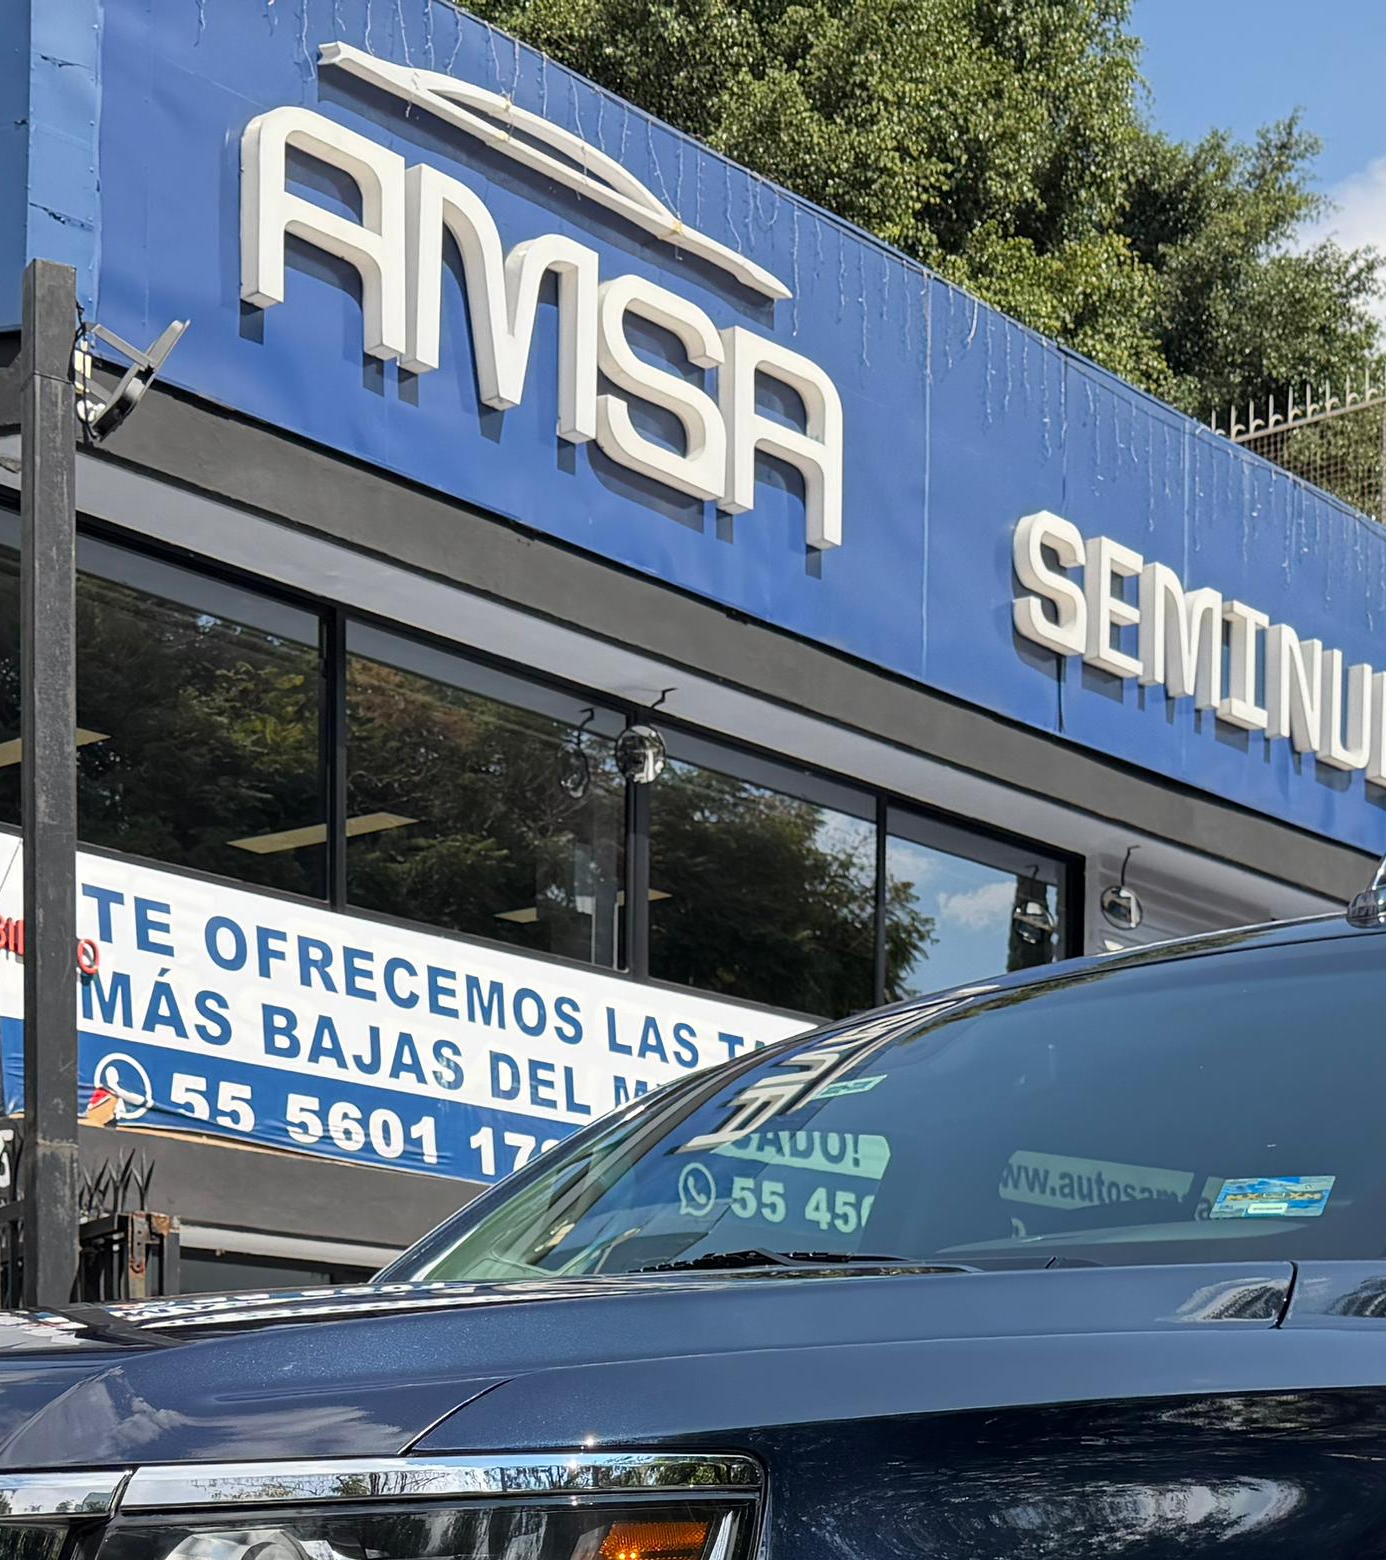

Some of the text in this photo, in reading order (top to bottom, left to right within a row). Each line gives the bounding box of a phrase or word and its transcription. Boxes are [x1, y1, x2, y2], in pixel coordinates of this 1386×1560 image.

[239, 106, 843, 550] AMSA
[81, 968, 233, 1046] MÁS
[262, 1003, 465, 1091] BAJAS
[490, 1050, 592, 1116] DEL
[82, 883, 174, 957] TE
[205, 915, 584, 1046] OFRECEMOS
[606, 1006, 699, 1070] LAS
[170, 1072, 558, 1177] 55 5601 17
[731, 1175, 787, 1224] 55
